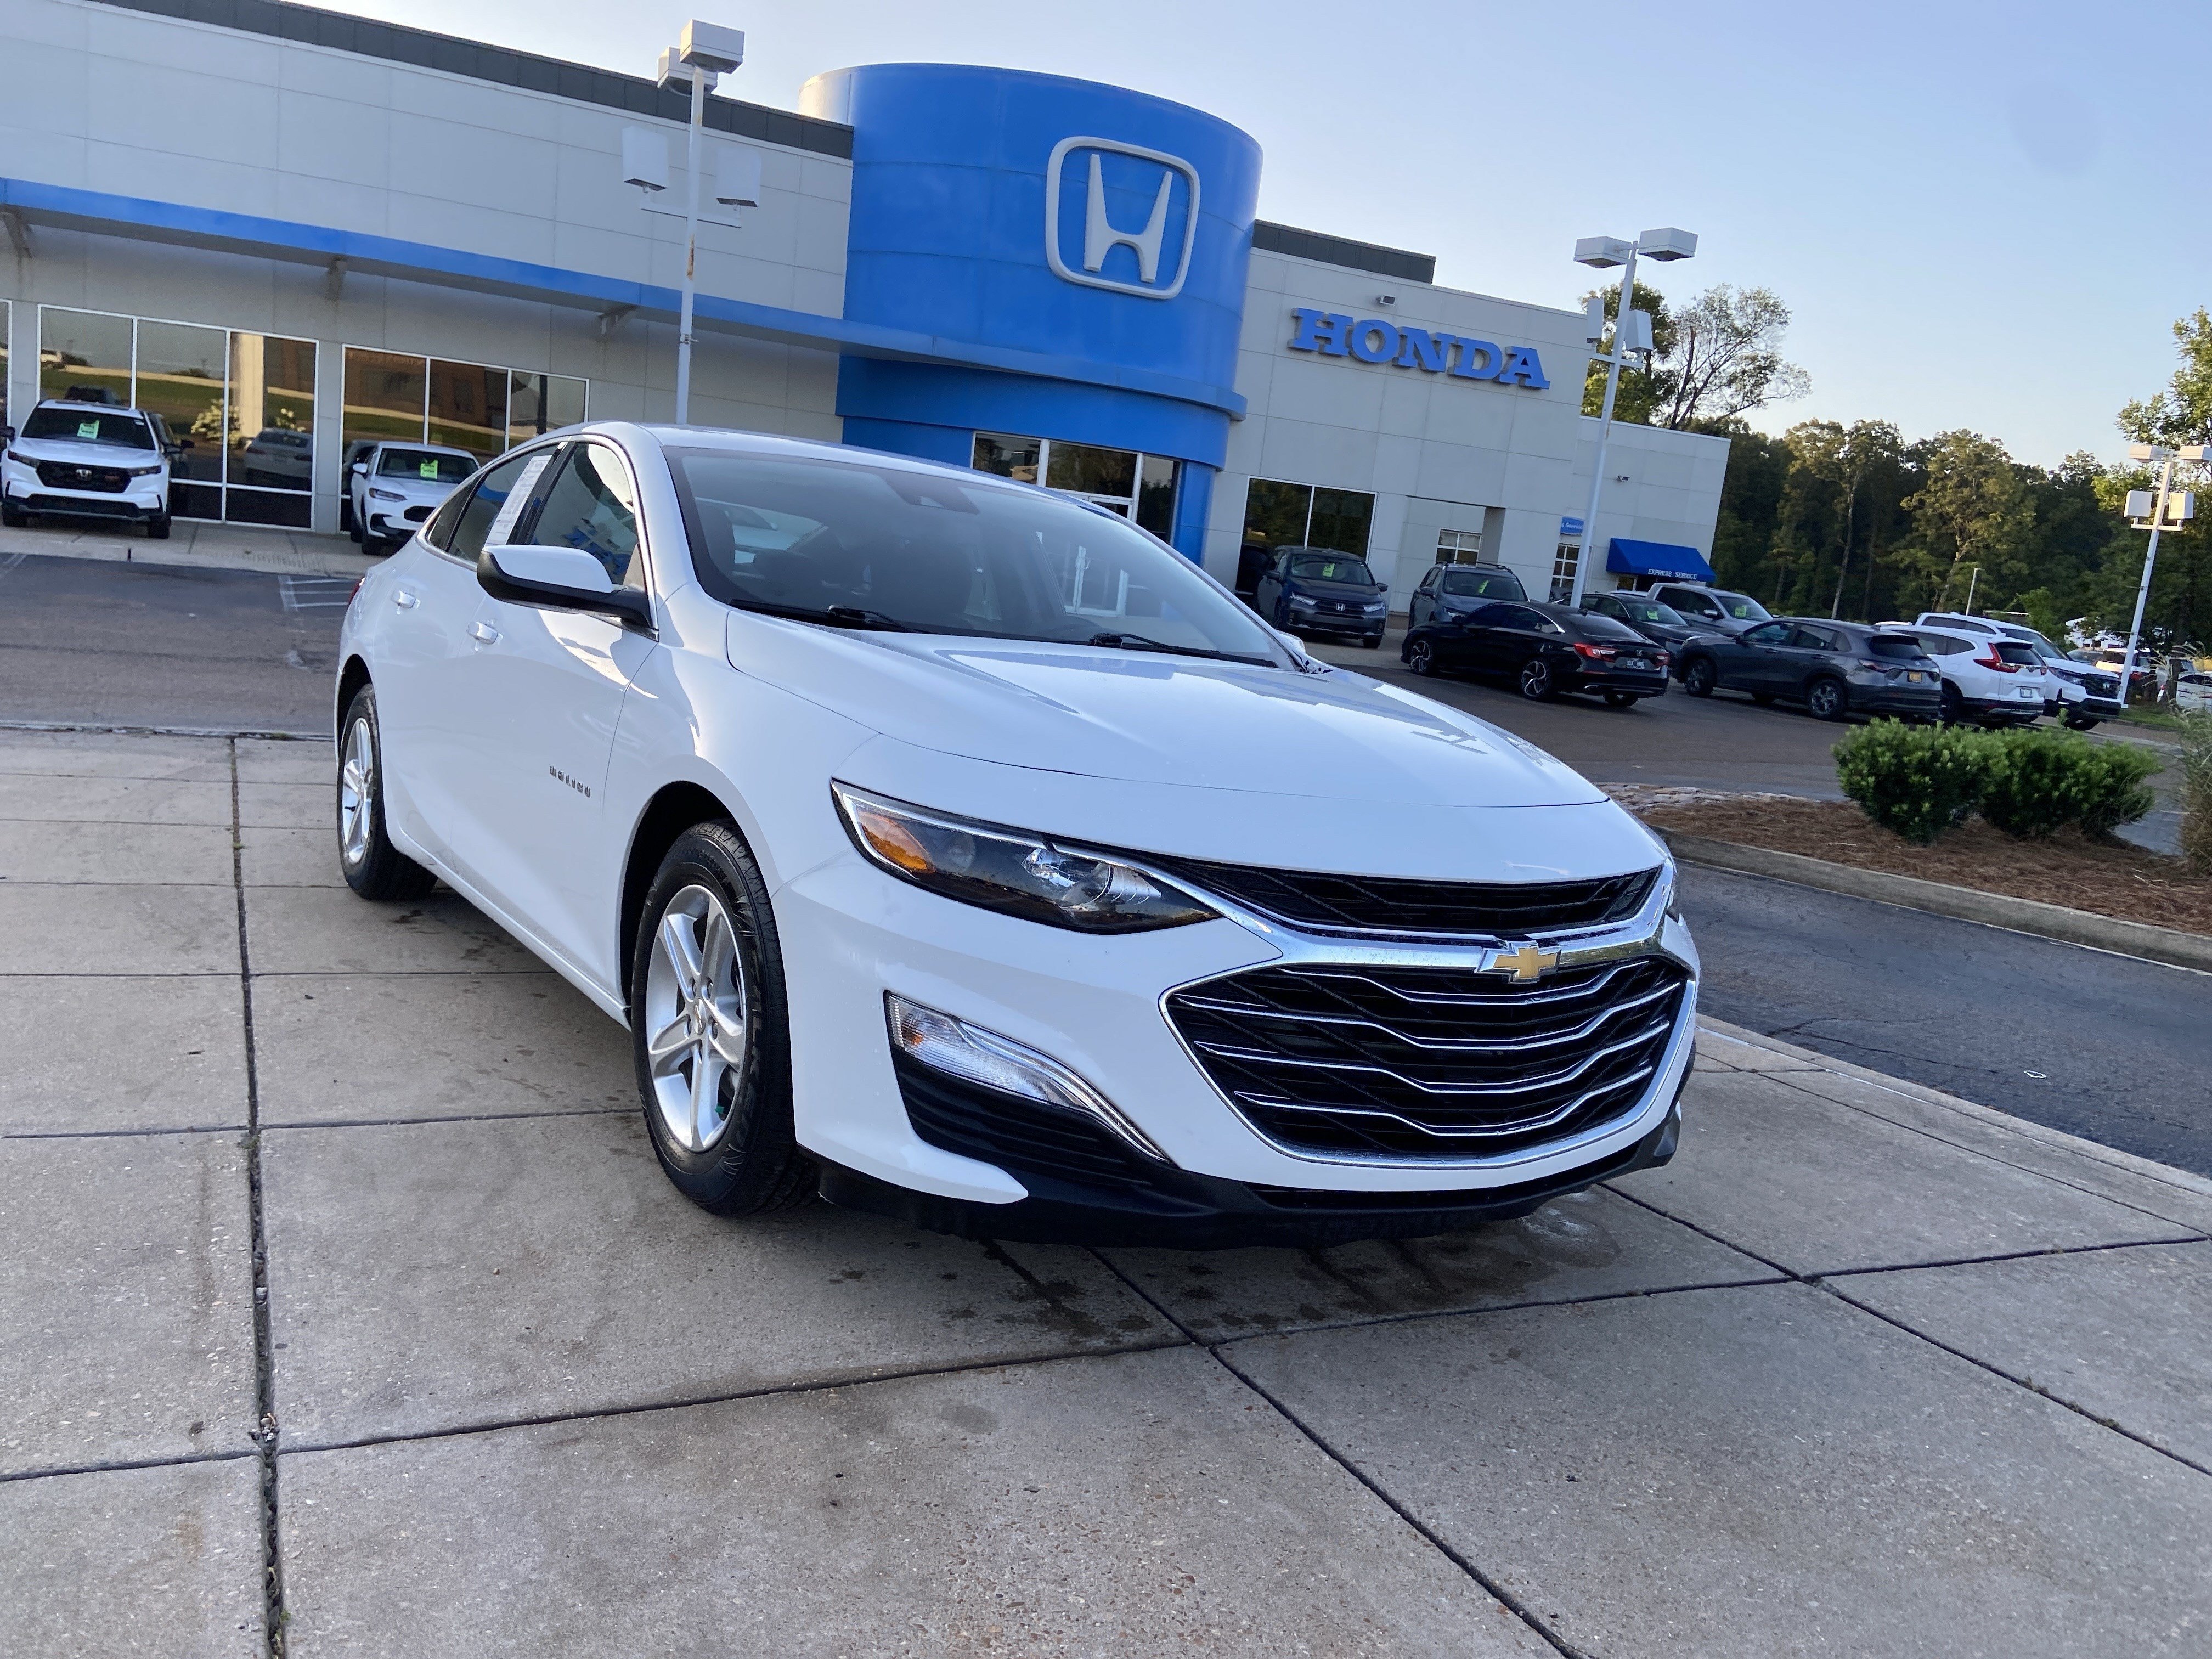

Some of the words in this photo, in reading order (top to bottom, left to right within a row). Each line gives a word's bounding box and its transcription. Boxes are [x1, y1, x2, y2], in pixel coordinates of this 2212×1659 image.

[1288, 307, 1550, 390] HONDA
[1647, 568, 1672, 577] EXPRESS
[1675, 572, 1697, 580] SERVICE
